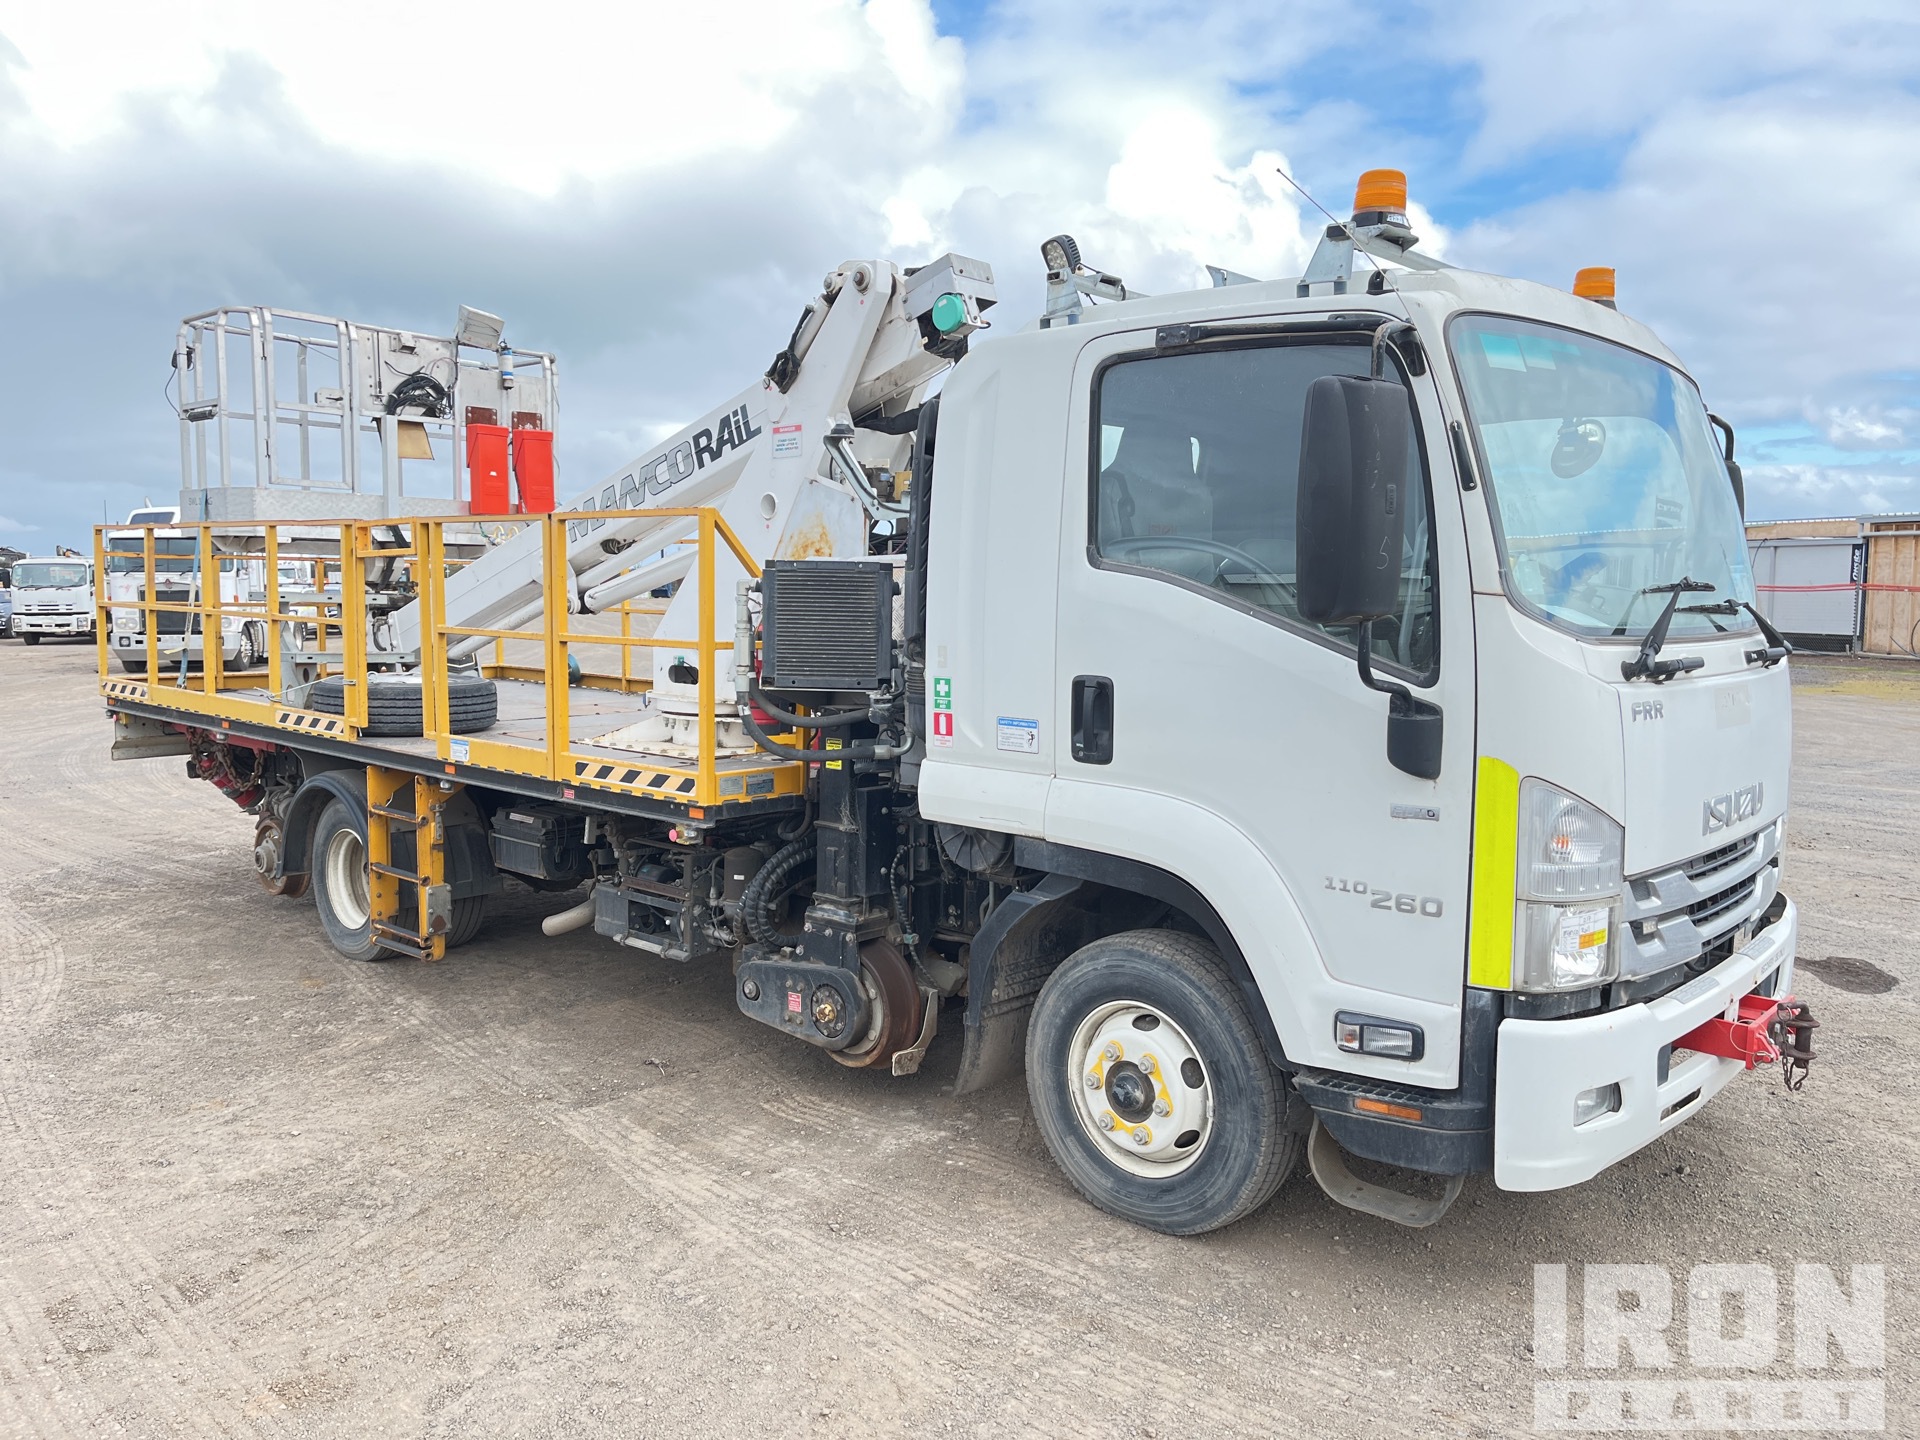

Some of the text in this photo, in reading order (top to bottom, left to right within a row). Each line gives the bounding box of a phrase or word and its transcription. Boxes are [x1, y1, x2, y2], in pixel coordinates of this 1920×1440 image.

[1631, 700, 1664, 722] FRR
[1702, 780, 1763, 836] ISUZU
[1324, 876, 1368, 895] 110
[1370, 888, 1443, 918] 260
